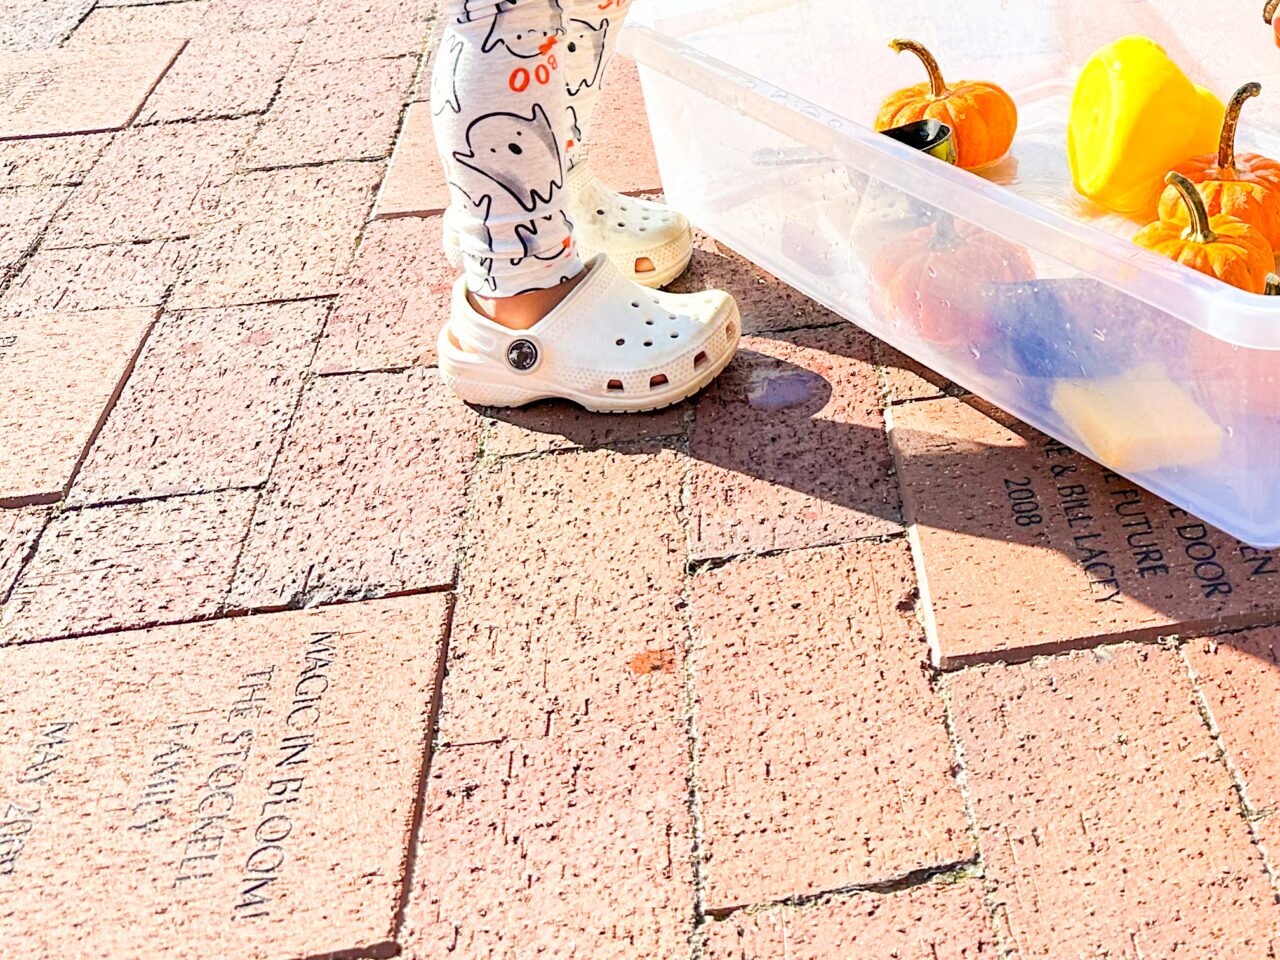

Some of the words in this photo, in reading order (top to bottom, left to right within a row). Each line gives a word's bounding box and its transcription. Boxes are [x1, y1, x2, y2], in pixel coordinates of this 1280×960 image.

[1003, 476, 1043, 527] 2008
[1050, 464, 1078, 480] &
[1056, 483, 1094, 529] BILL
[1110, 488, 1170, 579] FUTURE
[1073, 533, 1125, 604] LACEY
[227, 663, 276, 723] THE
[286, 630, 340, 727] MAGIC
[16, 721, 79, 785] MAY
[127, 722, 199, 832] FAMILY
[275, 734, 315, 768] IN
[171, 728, 255, 889] STOCKELL
[230, 776, 305, 922] BLOOM!
